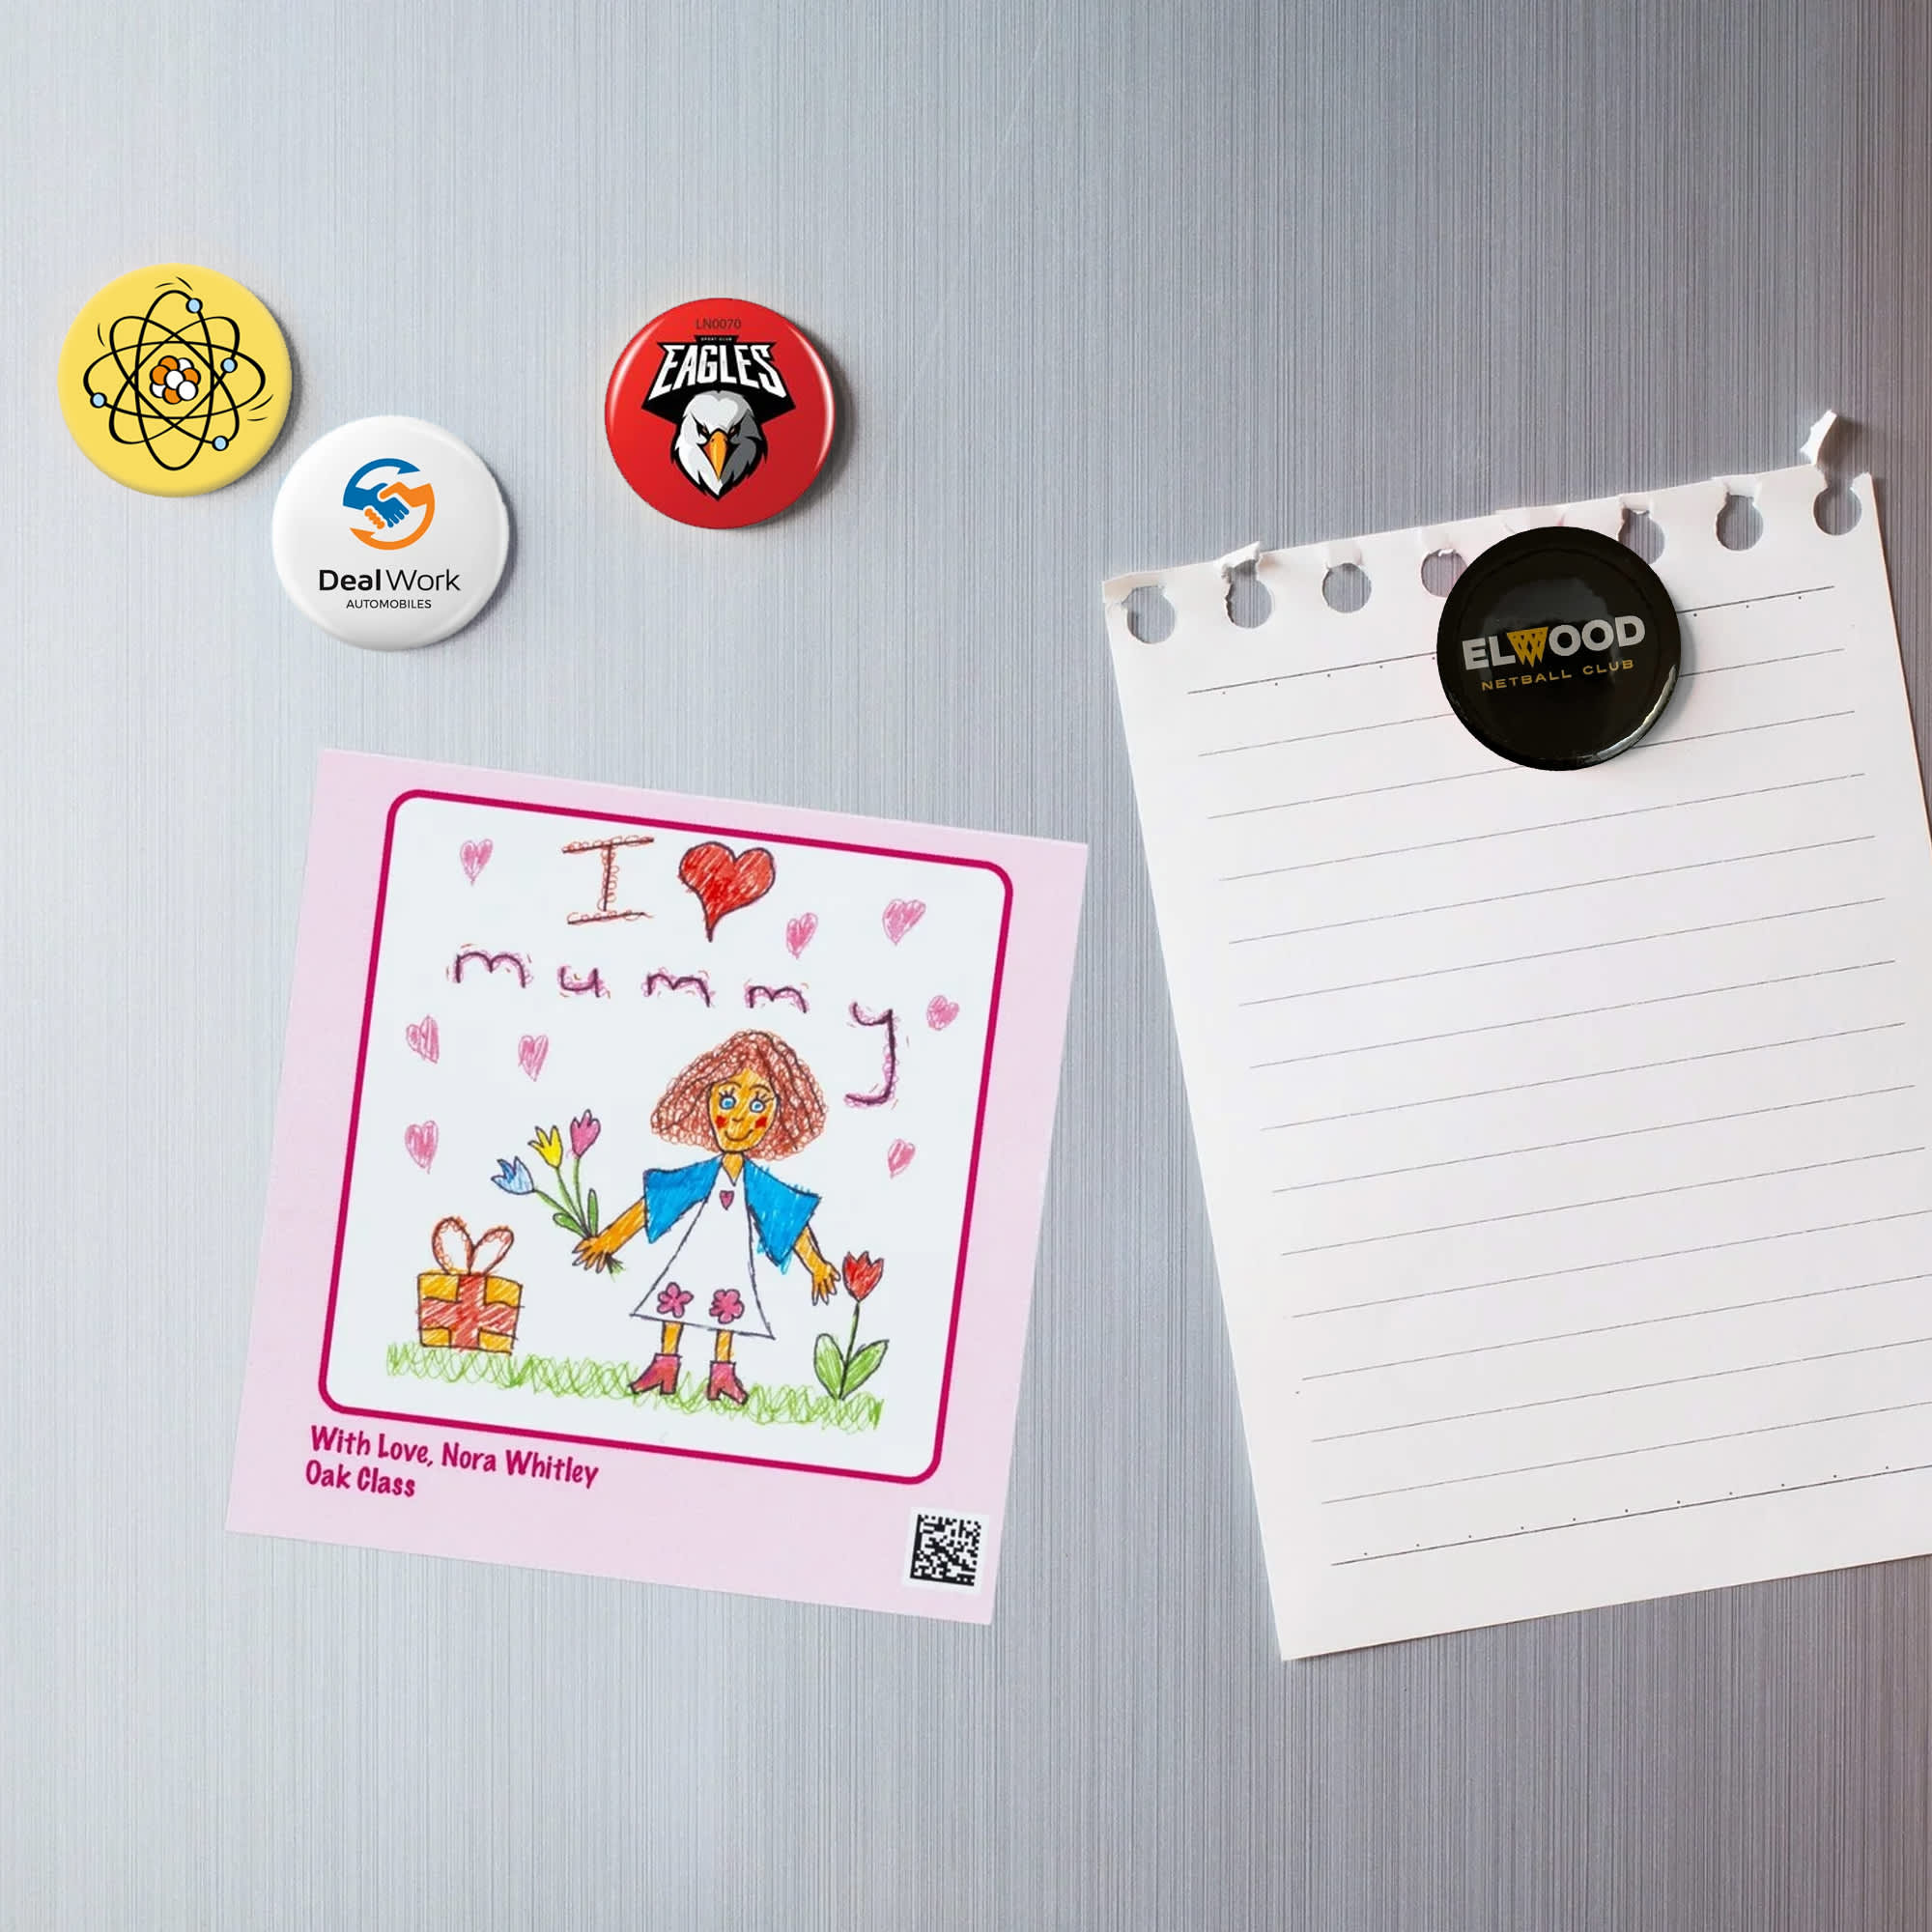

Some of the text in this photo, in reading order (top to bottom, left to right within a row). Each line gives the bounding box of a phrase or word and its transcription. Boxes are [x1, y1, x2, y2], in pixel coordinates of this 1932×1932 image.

[695, 318, 742, 329] LN0070
[648, 344, 787, 400] EAGLES
[319, 568, 461, 591] Deal Work
[346, 599, 432, 609] AUTOMOBILES
[1462, 615, 1646, 670] ELWOOD
[1481, 659, 1634, 692] NETBALL CLUB
[562, 837, 655, 925] I
[310, 1425, 599, 1490] With Love, Nora Whitley
[305, 1460, 416, 1497] Oak Class
